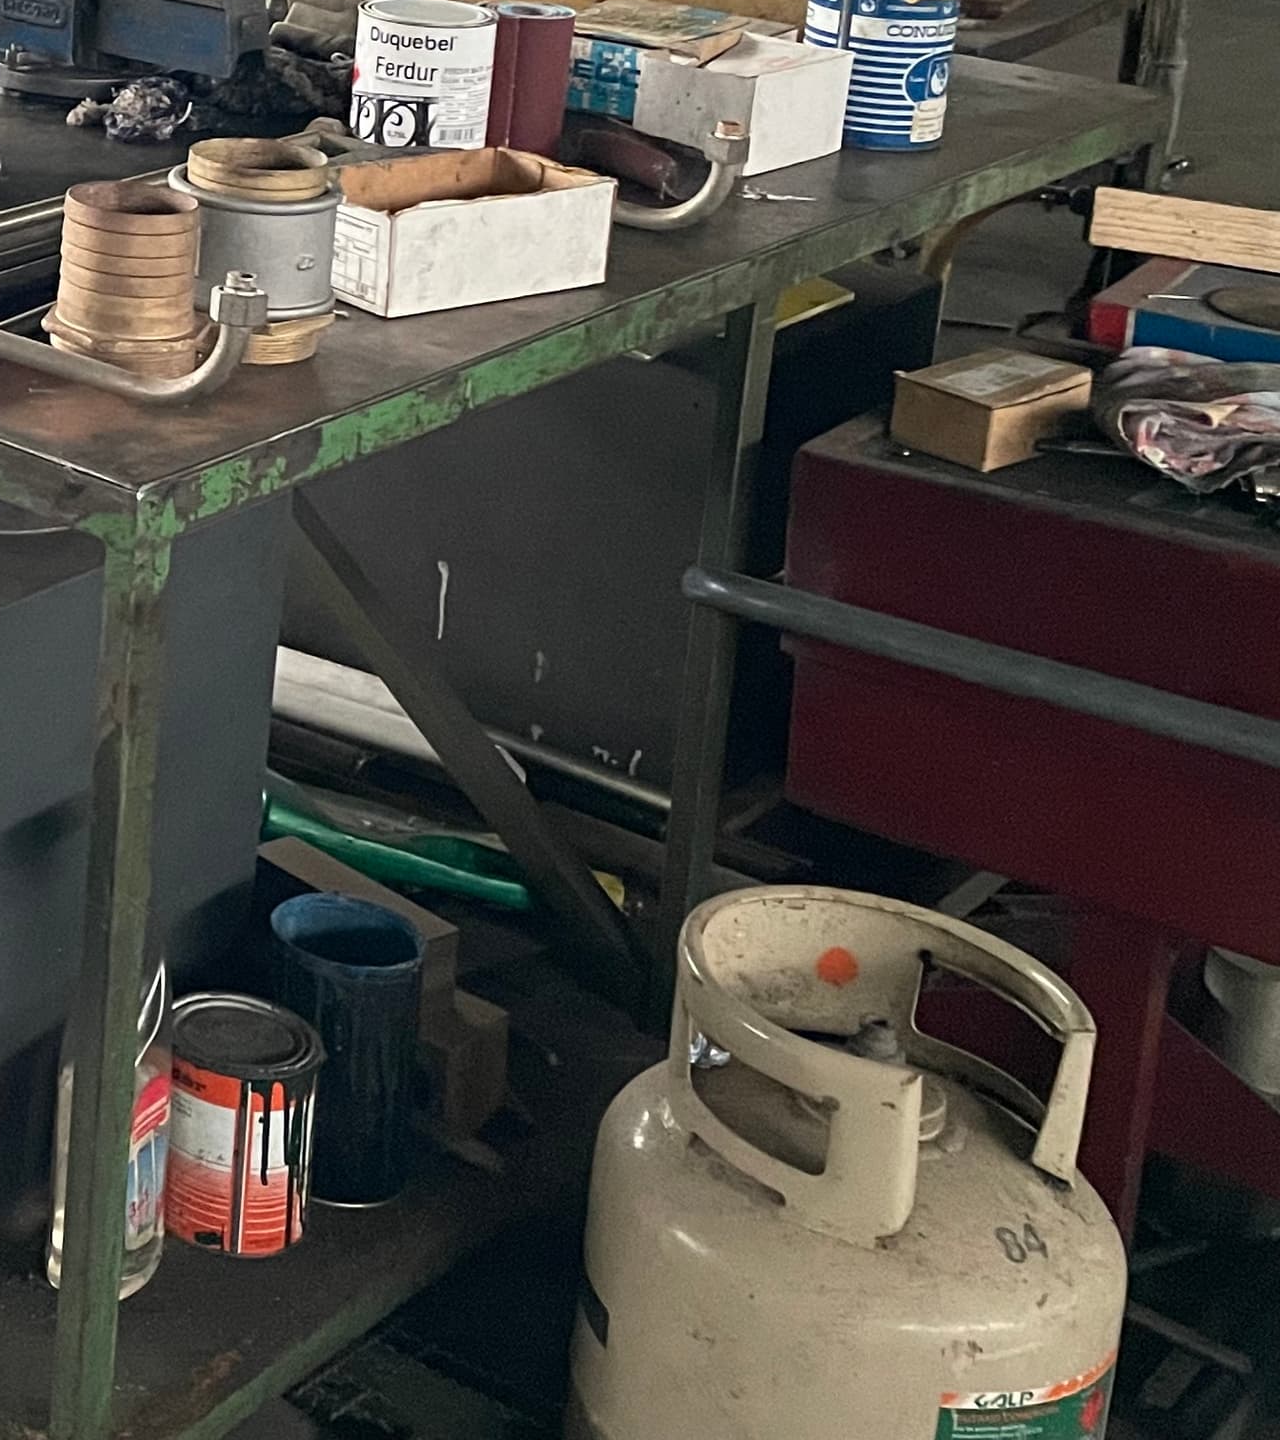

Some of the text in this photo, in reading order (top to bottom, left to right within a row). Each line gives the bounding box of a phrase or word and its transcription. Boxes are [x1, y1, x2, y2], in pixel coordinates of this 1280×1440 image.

[370, 26, 454, 51] Duquebel
[375, 56, 438, 81] Ferdur
[994, 1223, 1049, 1263] 84
